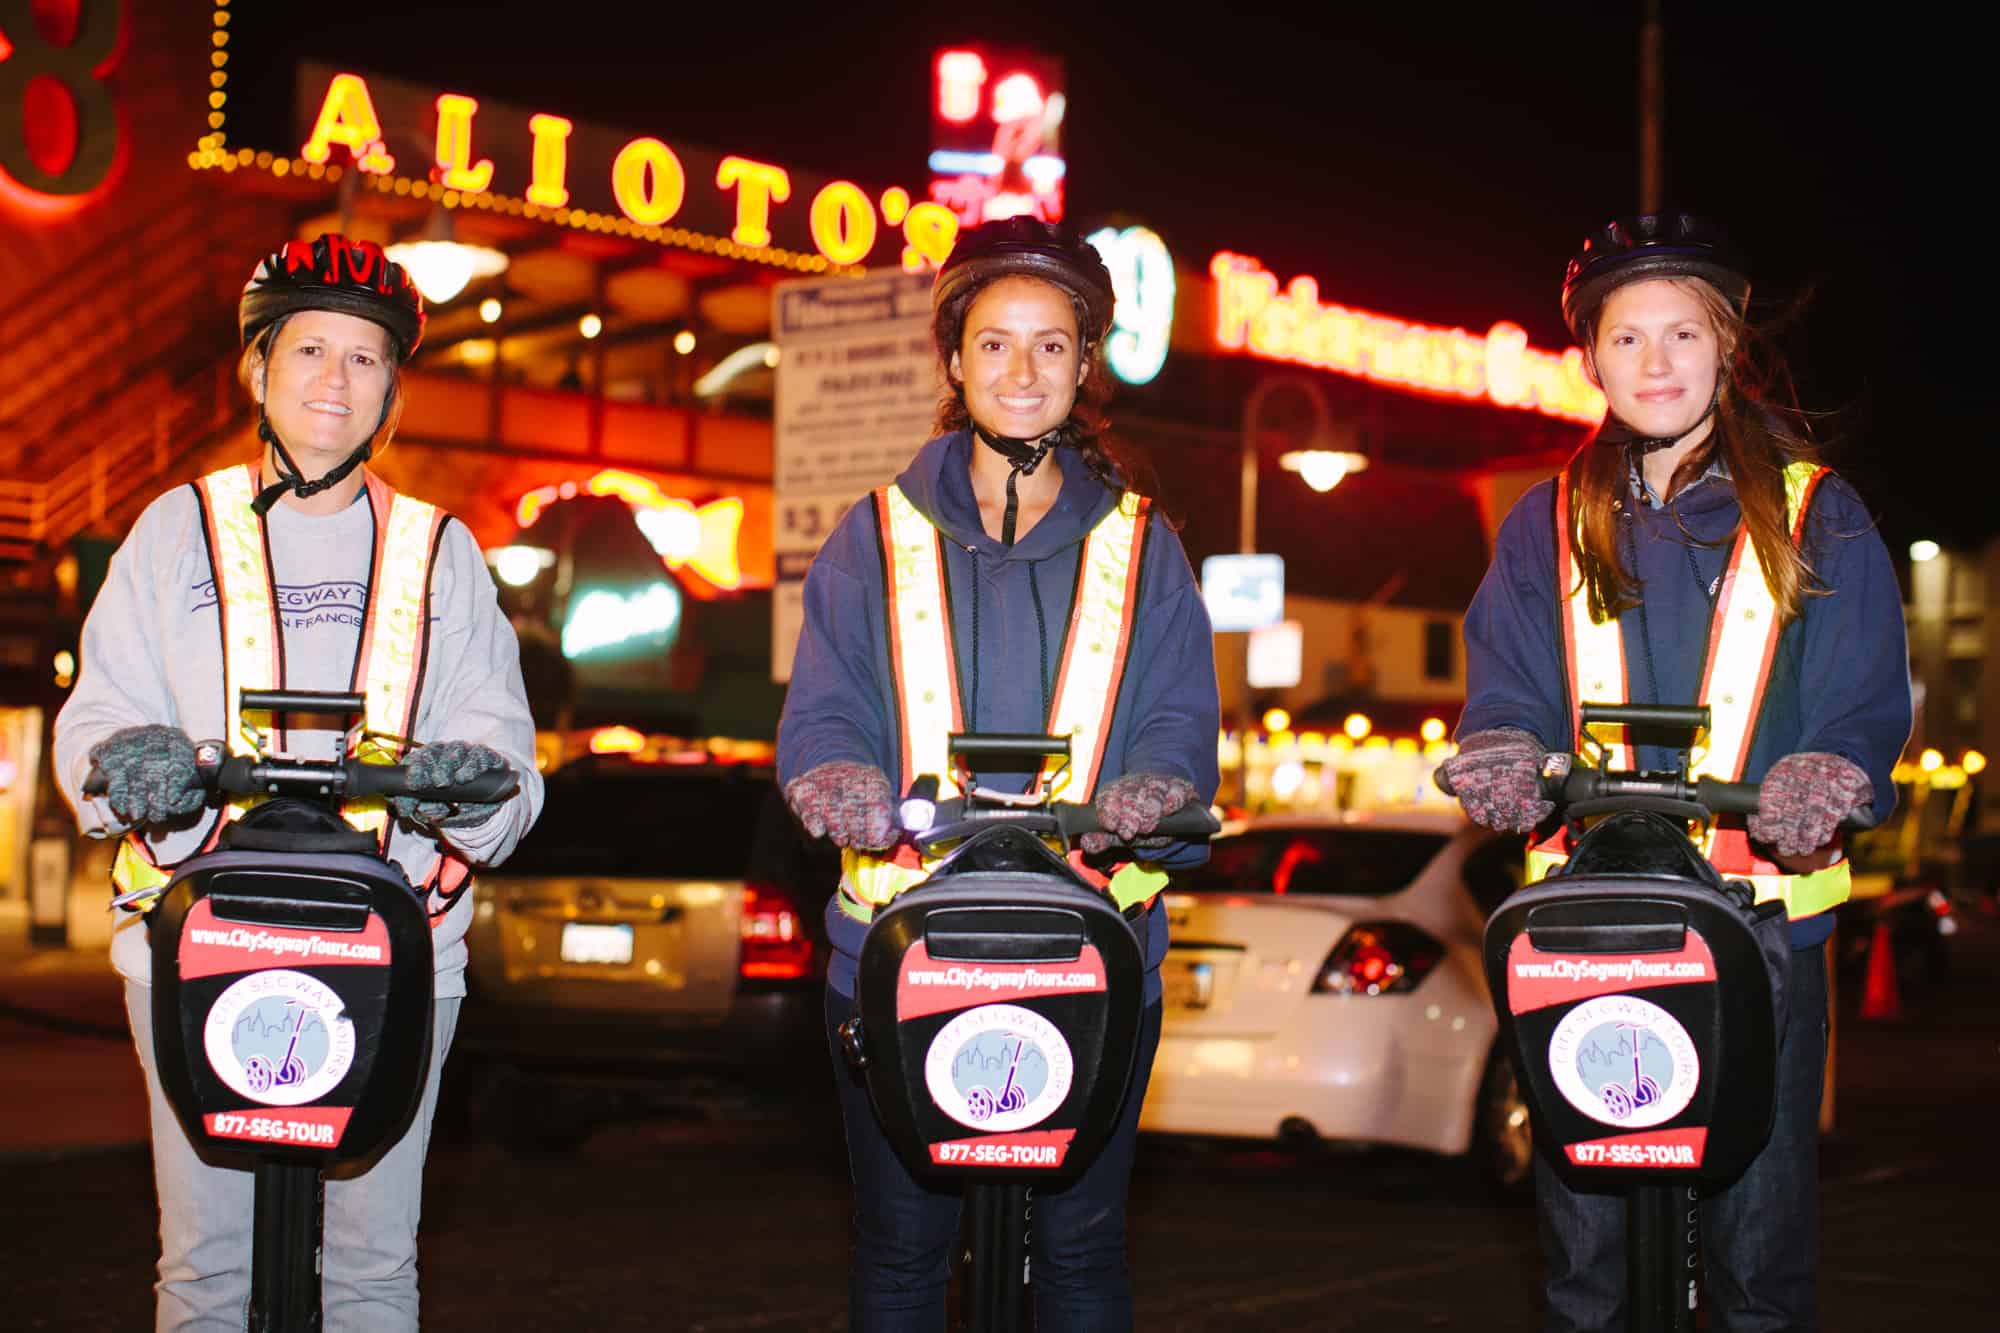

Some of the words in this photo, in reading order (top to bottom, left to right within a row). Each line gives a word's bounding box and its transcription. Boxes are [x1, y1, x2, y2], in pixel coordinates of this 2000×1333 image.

[302, 73, 959, 273] ALIOTO'S
[276, 587, 350, 605] EGWAY
[295, 611, 361, 629] FRANCIS
[191, 929, 381, 960] www.CitySegwayTours.com
[908, 967, 1097, 990] www.CitySegwayTours.com
[1515, 959, 1706, 982] www.CitySegwayTours.com
[213, 1113, 335, 1144] 877-SEG-TOUR
[938, 1143, 1057, 1164] 877-SEG-TOUR
[1575, 1145, 1696, 1165] 877-SEG-TOUR
